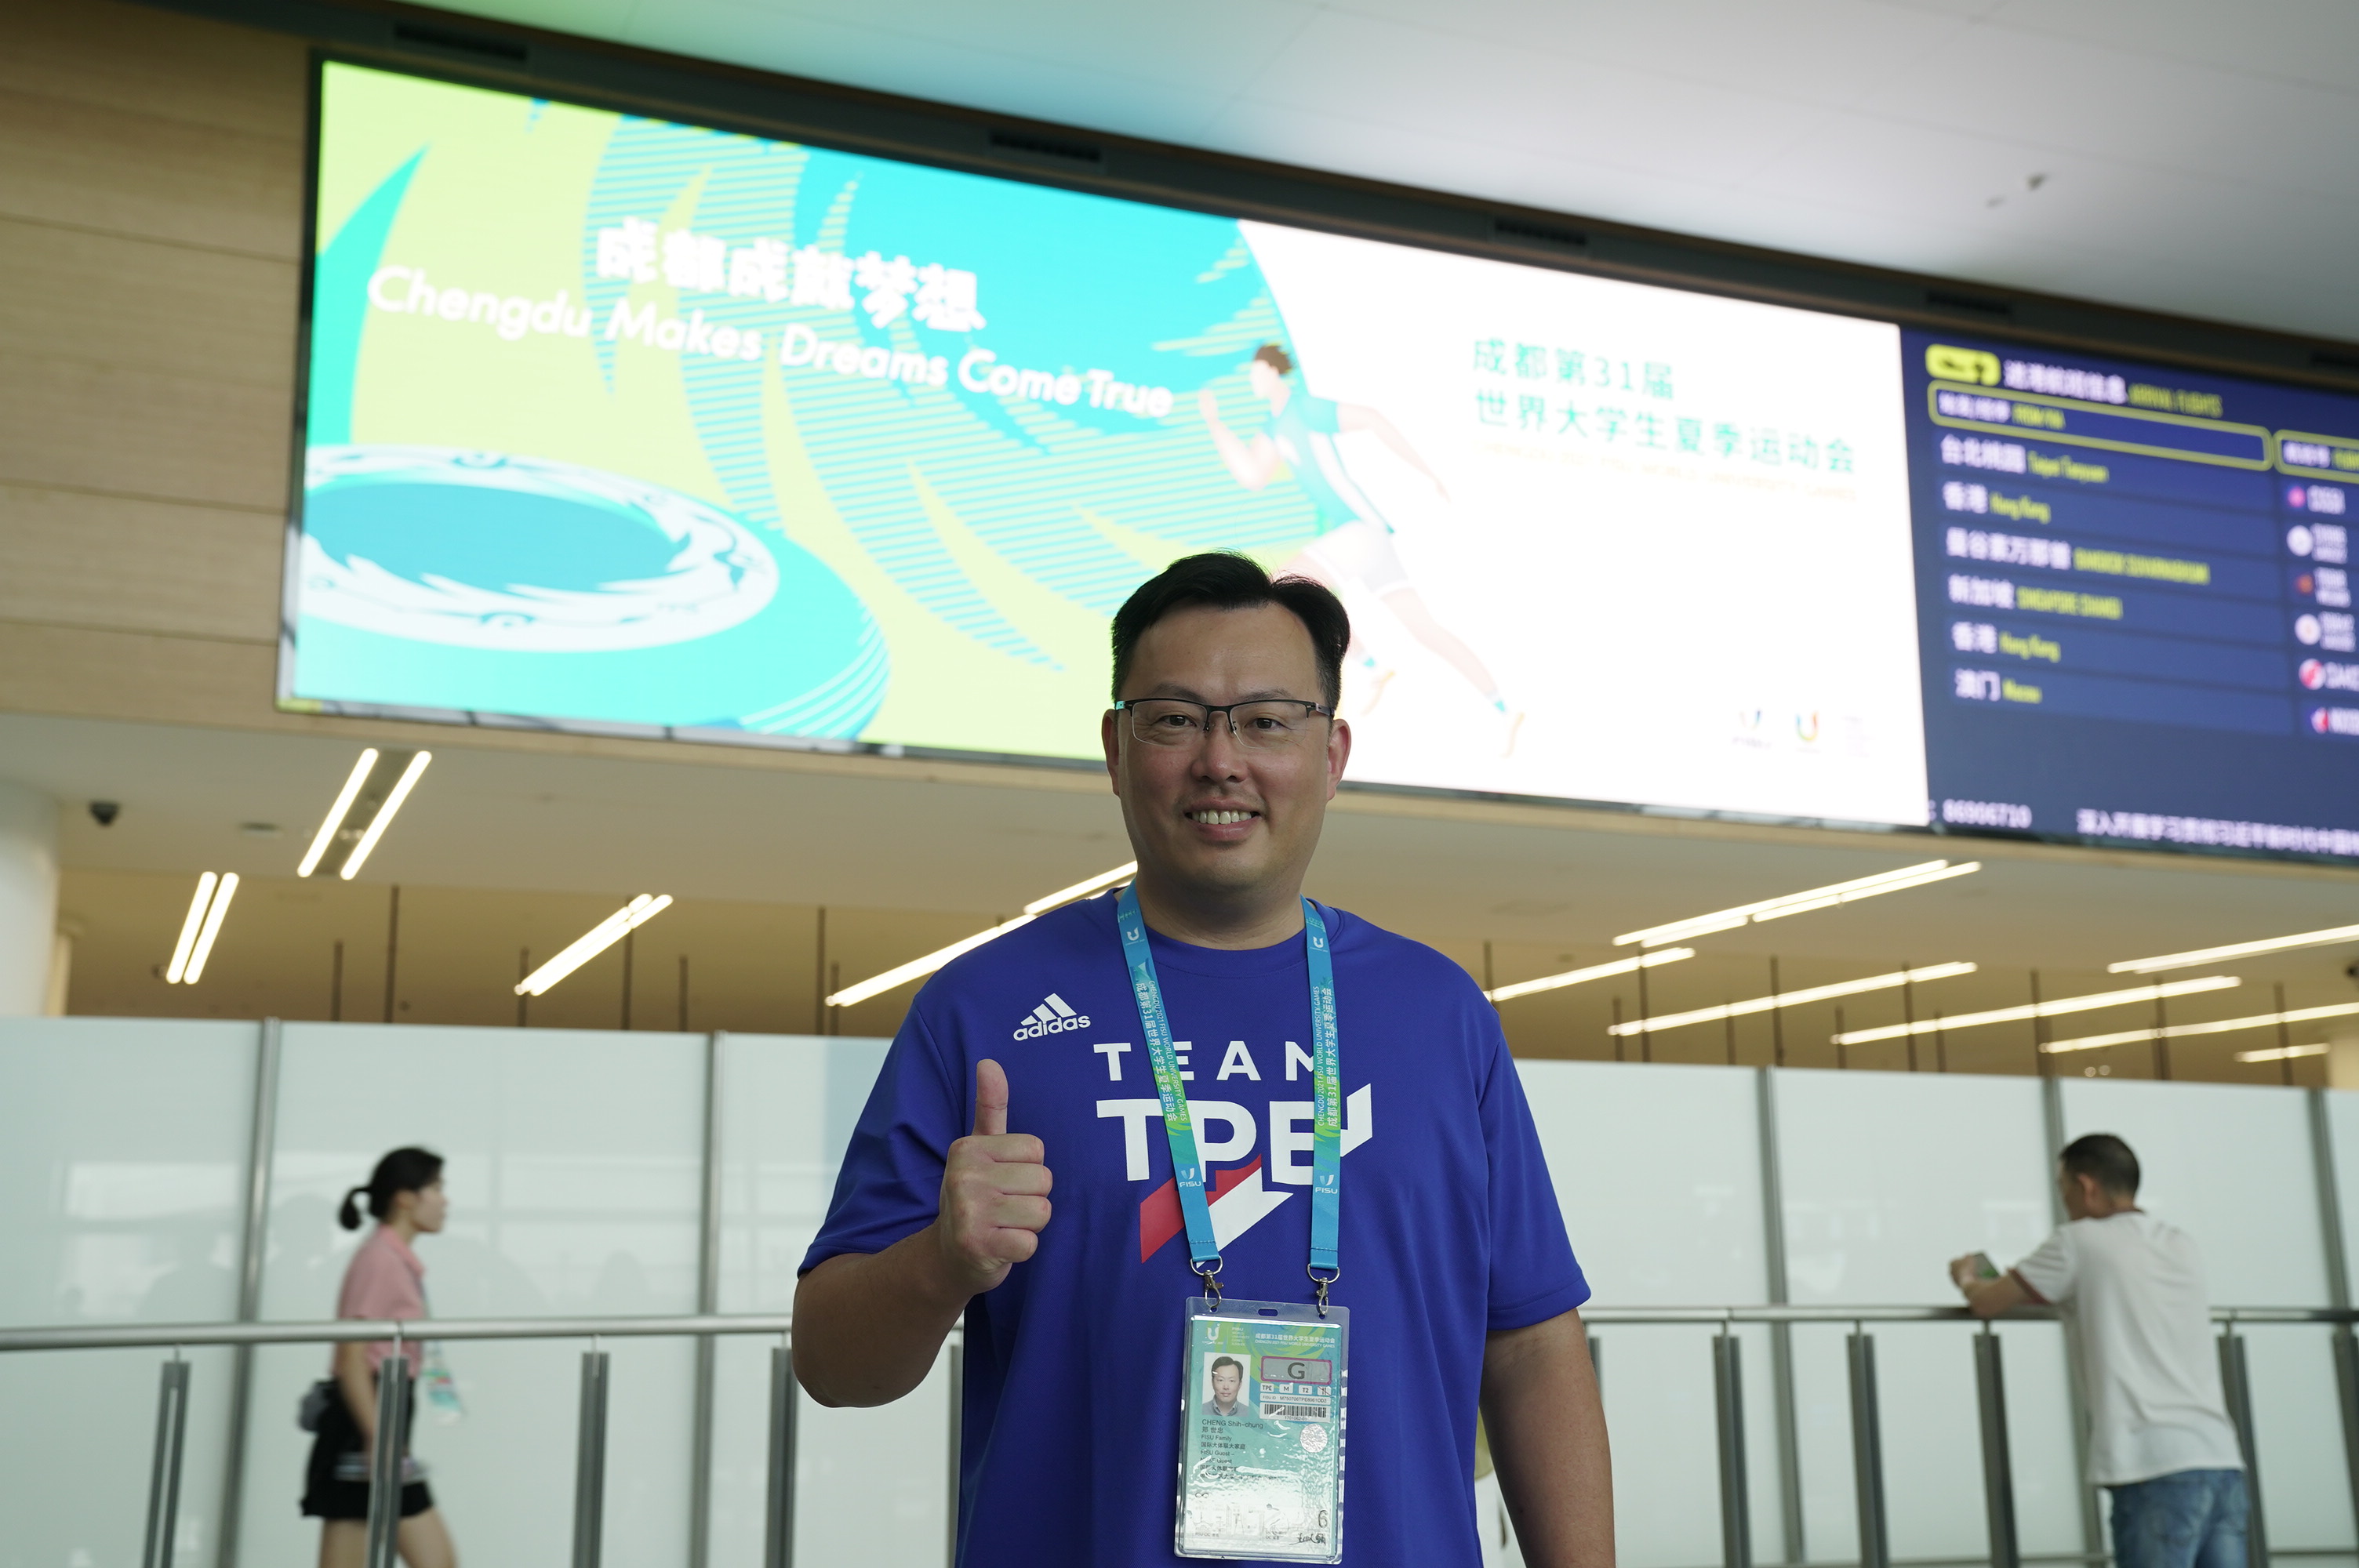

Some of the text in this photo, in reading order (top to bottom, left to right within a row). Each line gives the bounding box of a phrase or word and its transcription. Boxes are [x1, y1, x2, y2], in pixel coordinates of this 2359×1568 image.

[367, 264, 1173, 418] Chengdu Makes Dreams Come True
[1474, 338, 1674, 401] 成都第31届
[1474, 389, 1854, 474] 世界大学生夏季运动会
[1013, 1015, 1091, 1041] adidas
[1136, 982, 1177, 1122] 成都第31届世界大学生夏季运动会
[1149, 980, 1187, 1121] CHENGDU 2021 FISU WORLD UNIVERSITY GAMES
[1314, 1007, 1323, 1040] UNIVERSITY
[1321, 987, 1338, 1127] 成都第31届世界大学生夏季运动会
[1315, 1186, 1338, 1195] FISU
[1288, 1362, 1305, 1380] G
[1318, 1509, 1328, 1529] 6
